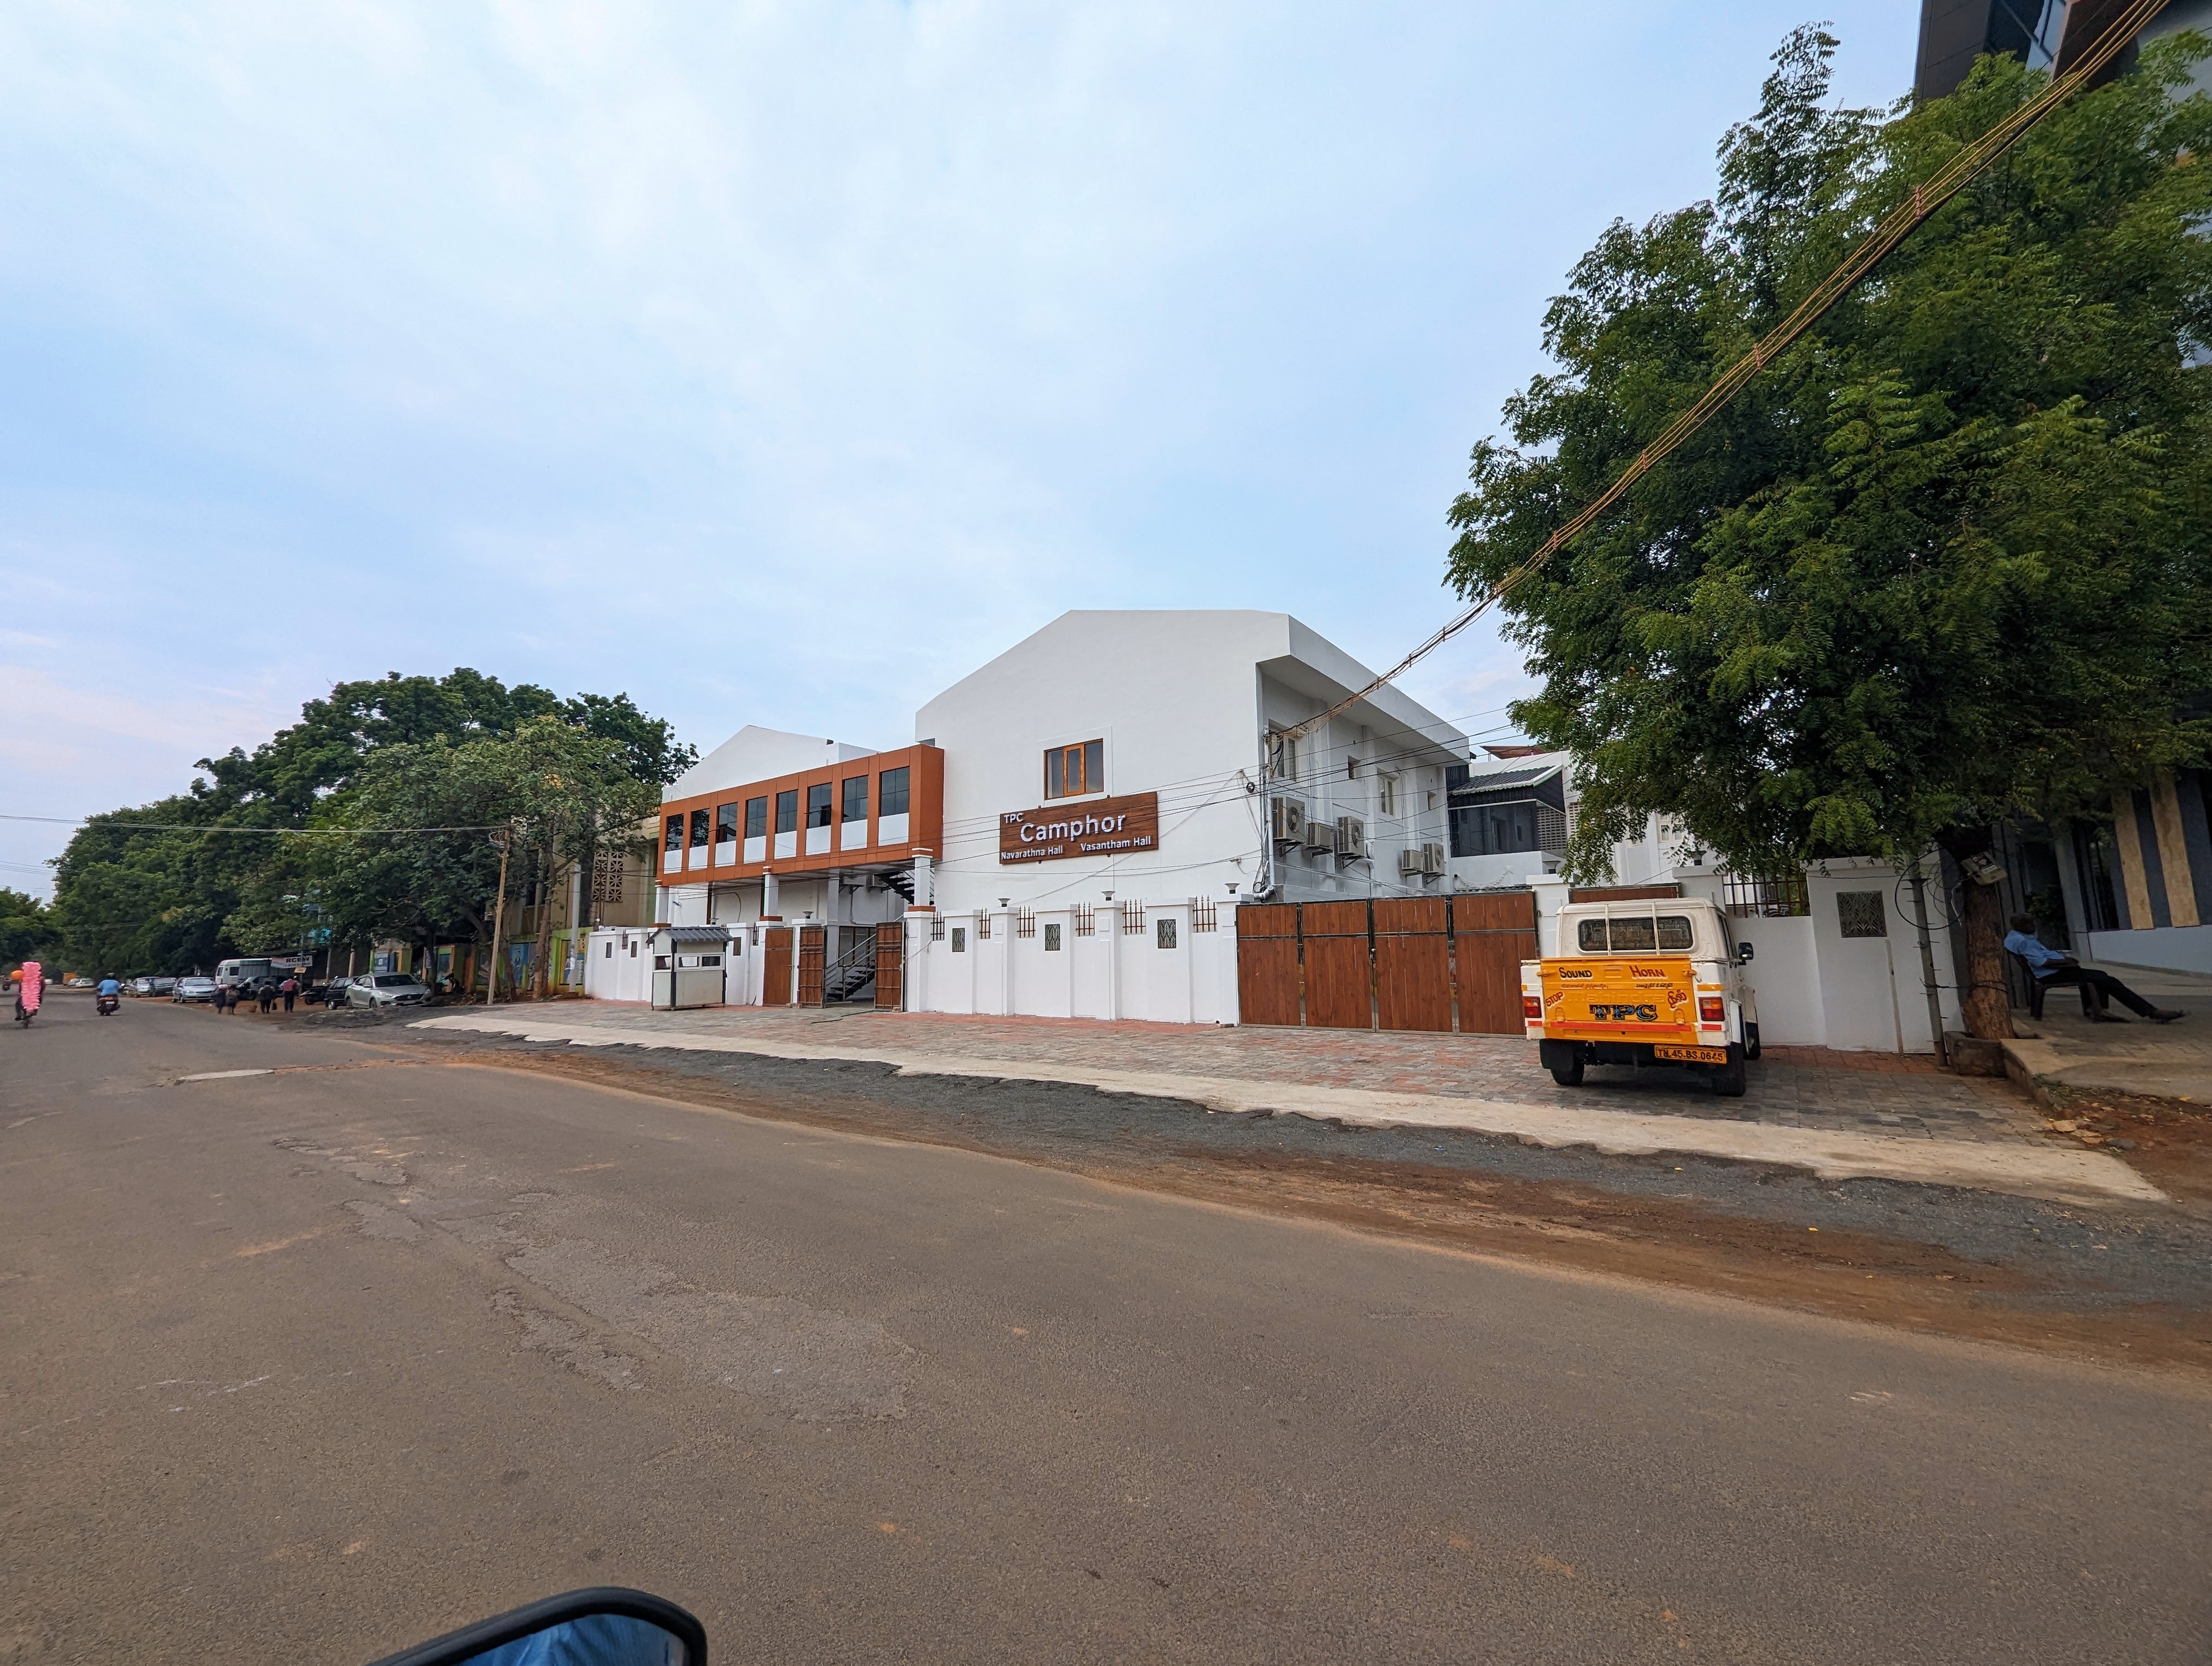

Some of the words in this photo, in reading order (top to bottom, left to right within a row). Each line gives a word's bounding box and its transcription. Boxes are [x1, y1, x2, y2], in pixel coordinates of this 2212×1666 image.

[1004, 812, 1025, 824] TPC
[1020, 814, 1127, 842] Camphor
[1080, 840, 1131, 852] Vasantham
[1133, 835, 1152, 847] Hall
[1001, 848, 1046, 860] Navarathna
[1047, 844, 1063, 855] Hall
[1559, 967, 1593, 978] SOUND
[1629, 965, 1666, 977] HORN
[1545, 991, 1564, 1007] STOP
[1589, 1004, 1658, 1022] TPC
